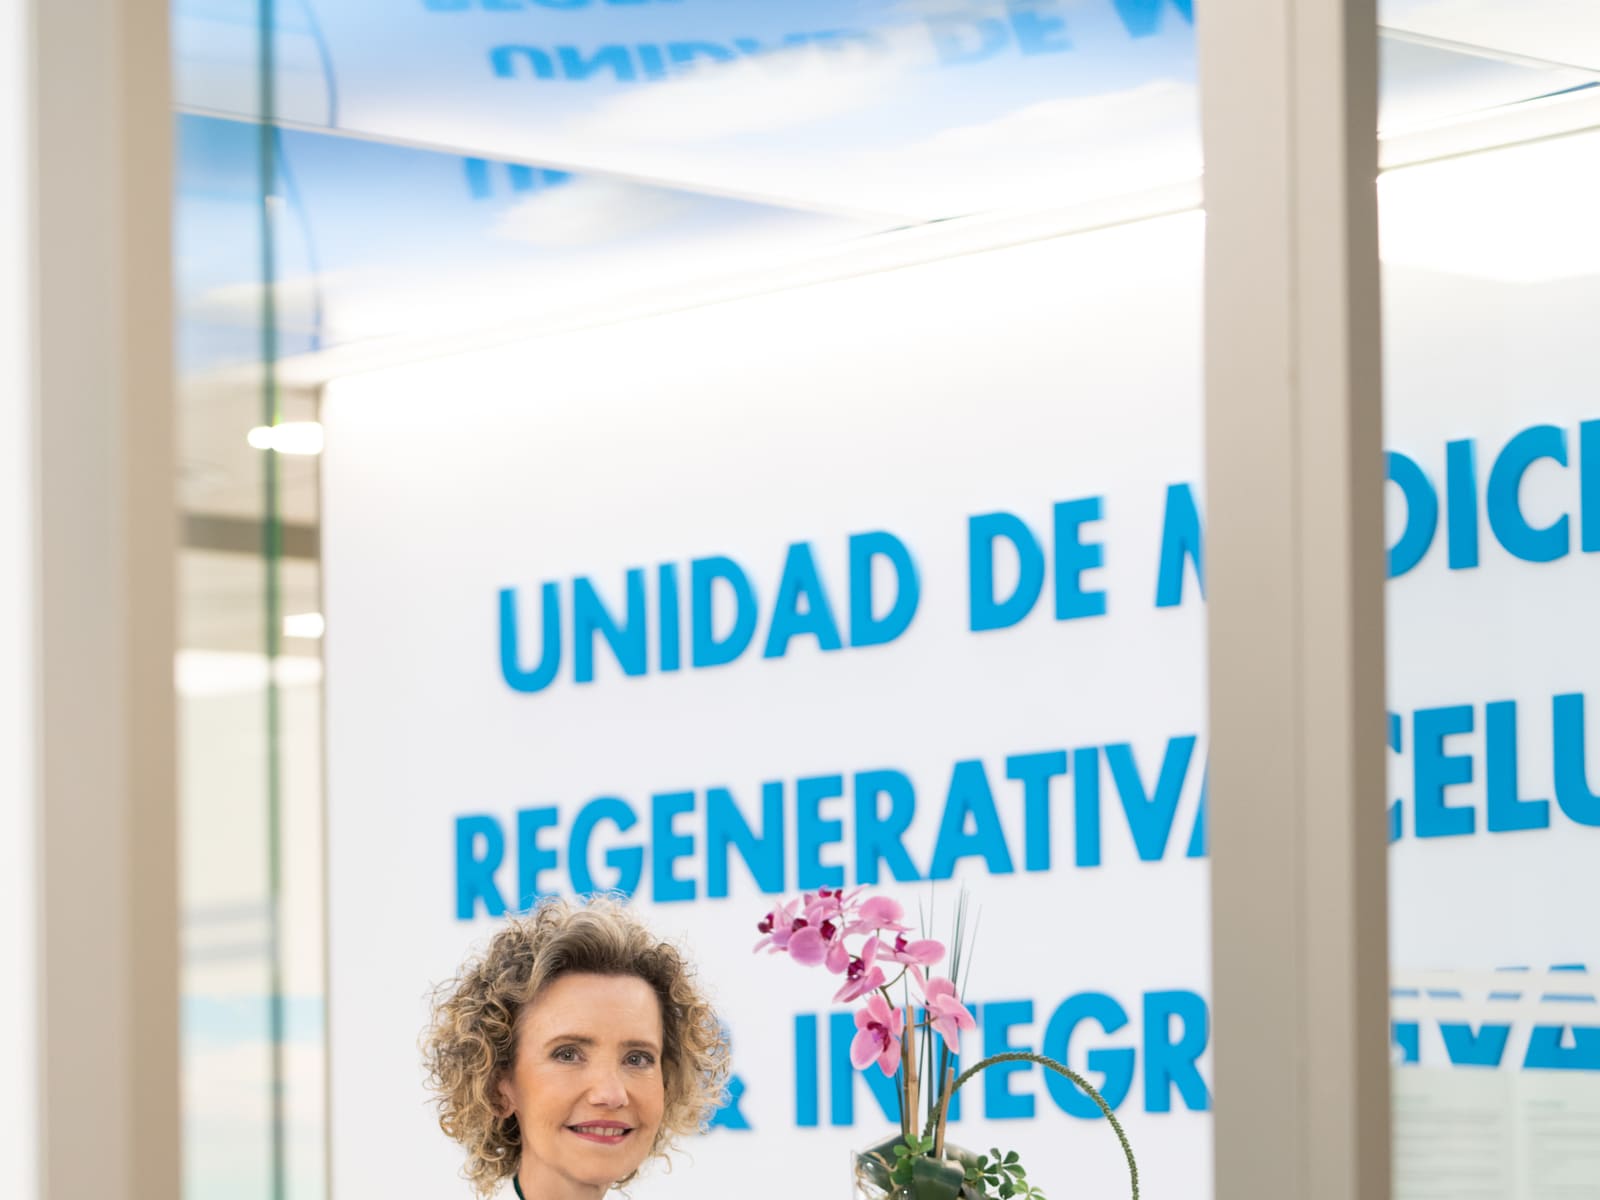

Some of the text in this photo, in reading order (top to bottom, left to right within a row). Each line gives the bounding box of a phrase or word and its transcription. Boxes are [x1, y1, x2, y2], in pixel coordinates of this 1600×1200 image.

[498, 530, 922, 693] UNIDAD
[967, 495, 1108, 632] DE
[1386, 692, 1600, 846] ELU
